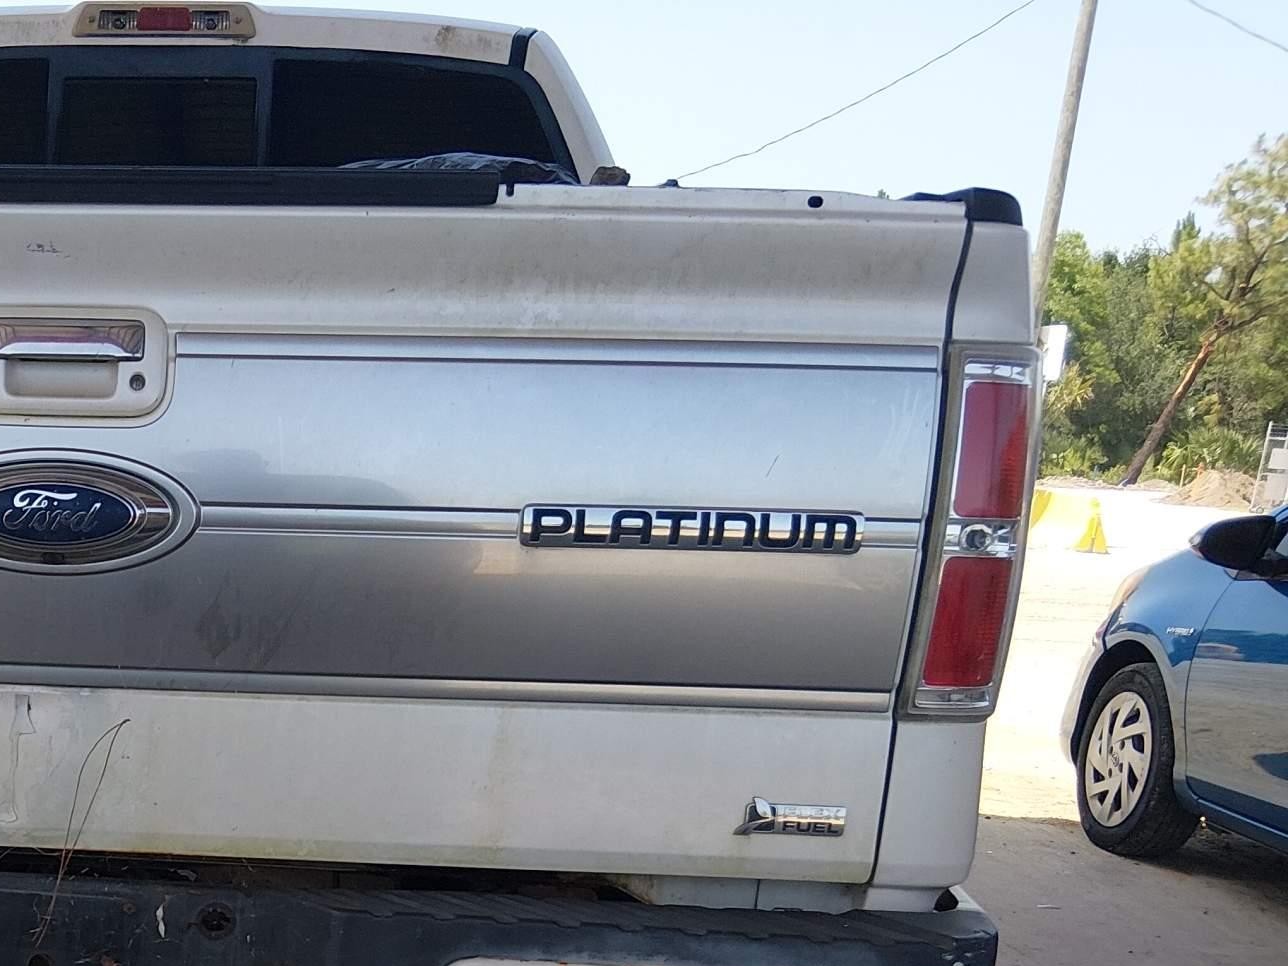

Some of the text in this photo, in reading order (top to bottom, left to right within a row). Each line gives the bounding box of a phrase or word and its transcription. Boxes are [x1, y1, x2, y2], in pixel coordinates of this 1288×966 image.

[3, 489, 102, 532] Ford
[529, 508, 857, 549] PLATINUM
[780, 806, 842, 820] FLEX
[782, 821, 839, 834] FUEL
